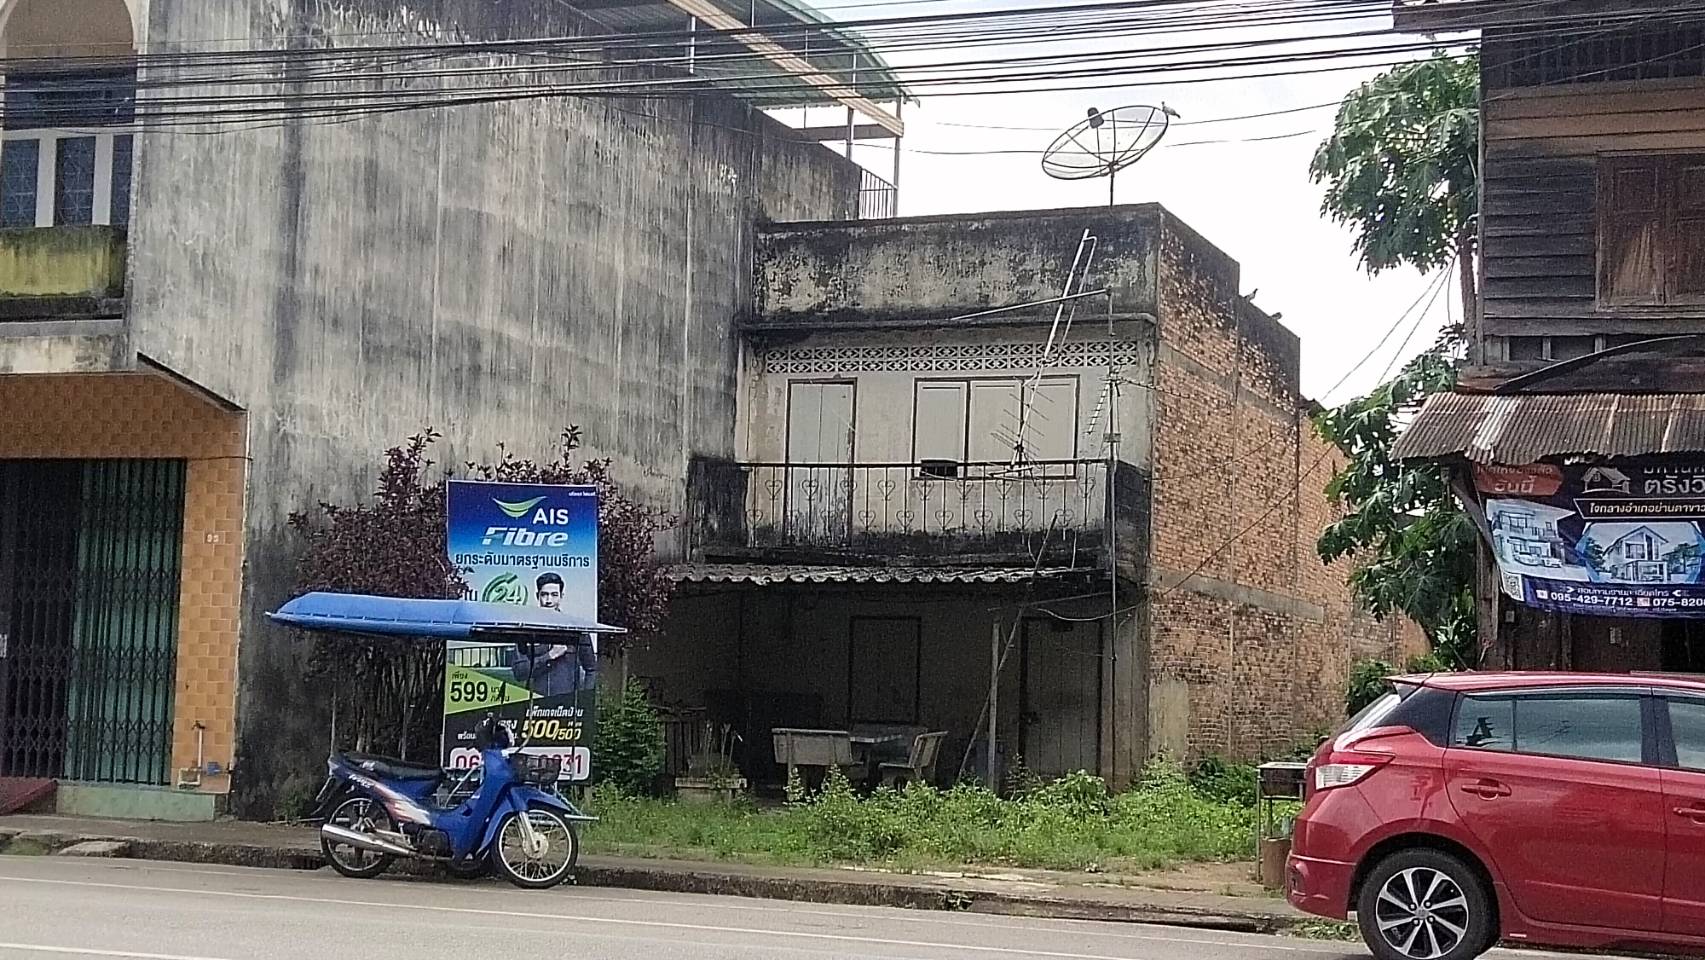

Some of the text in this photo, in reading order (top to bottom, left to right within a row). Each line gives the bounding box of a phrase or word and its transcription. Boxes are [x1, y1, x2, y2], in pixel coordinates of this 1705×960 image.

[1494, 475, 1537, 494] วันนี้
[532, 508, 569, 525] AIS
[481, 526, 569, 547] Fibre
[455, 551, 590, 570] ยกระดับมาตรฐานบริการ
[1550, 591, 1633, 607] 095-429-7712
[1652, 597, 1705, 607] 075-820
[450, 681, 488, 703] 599
